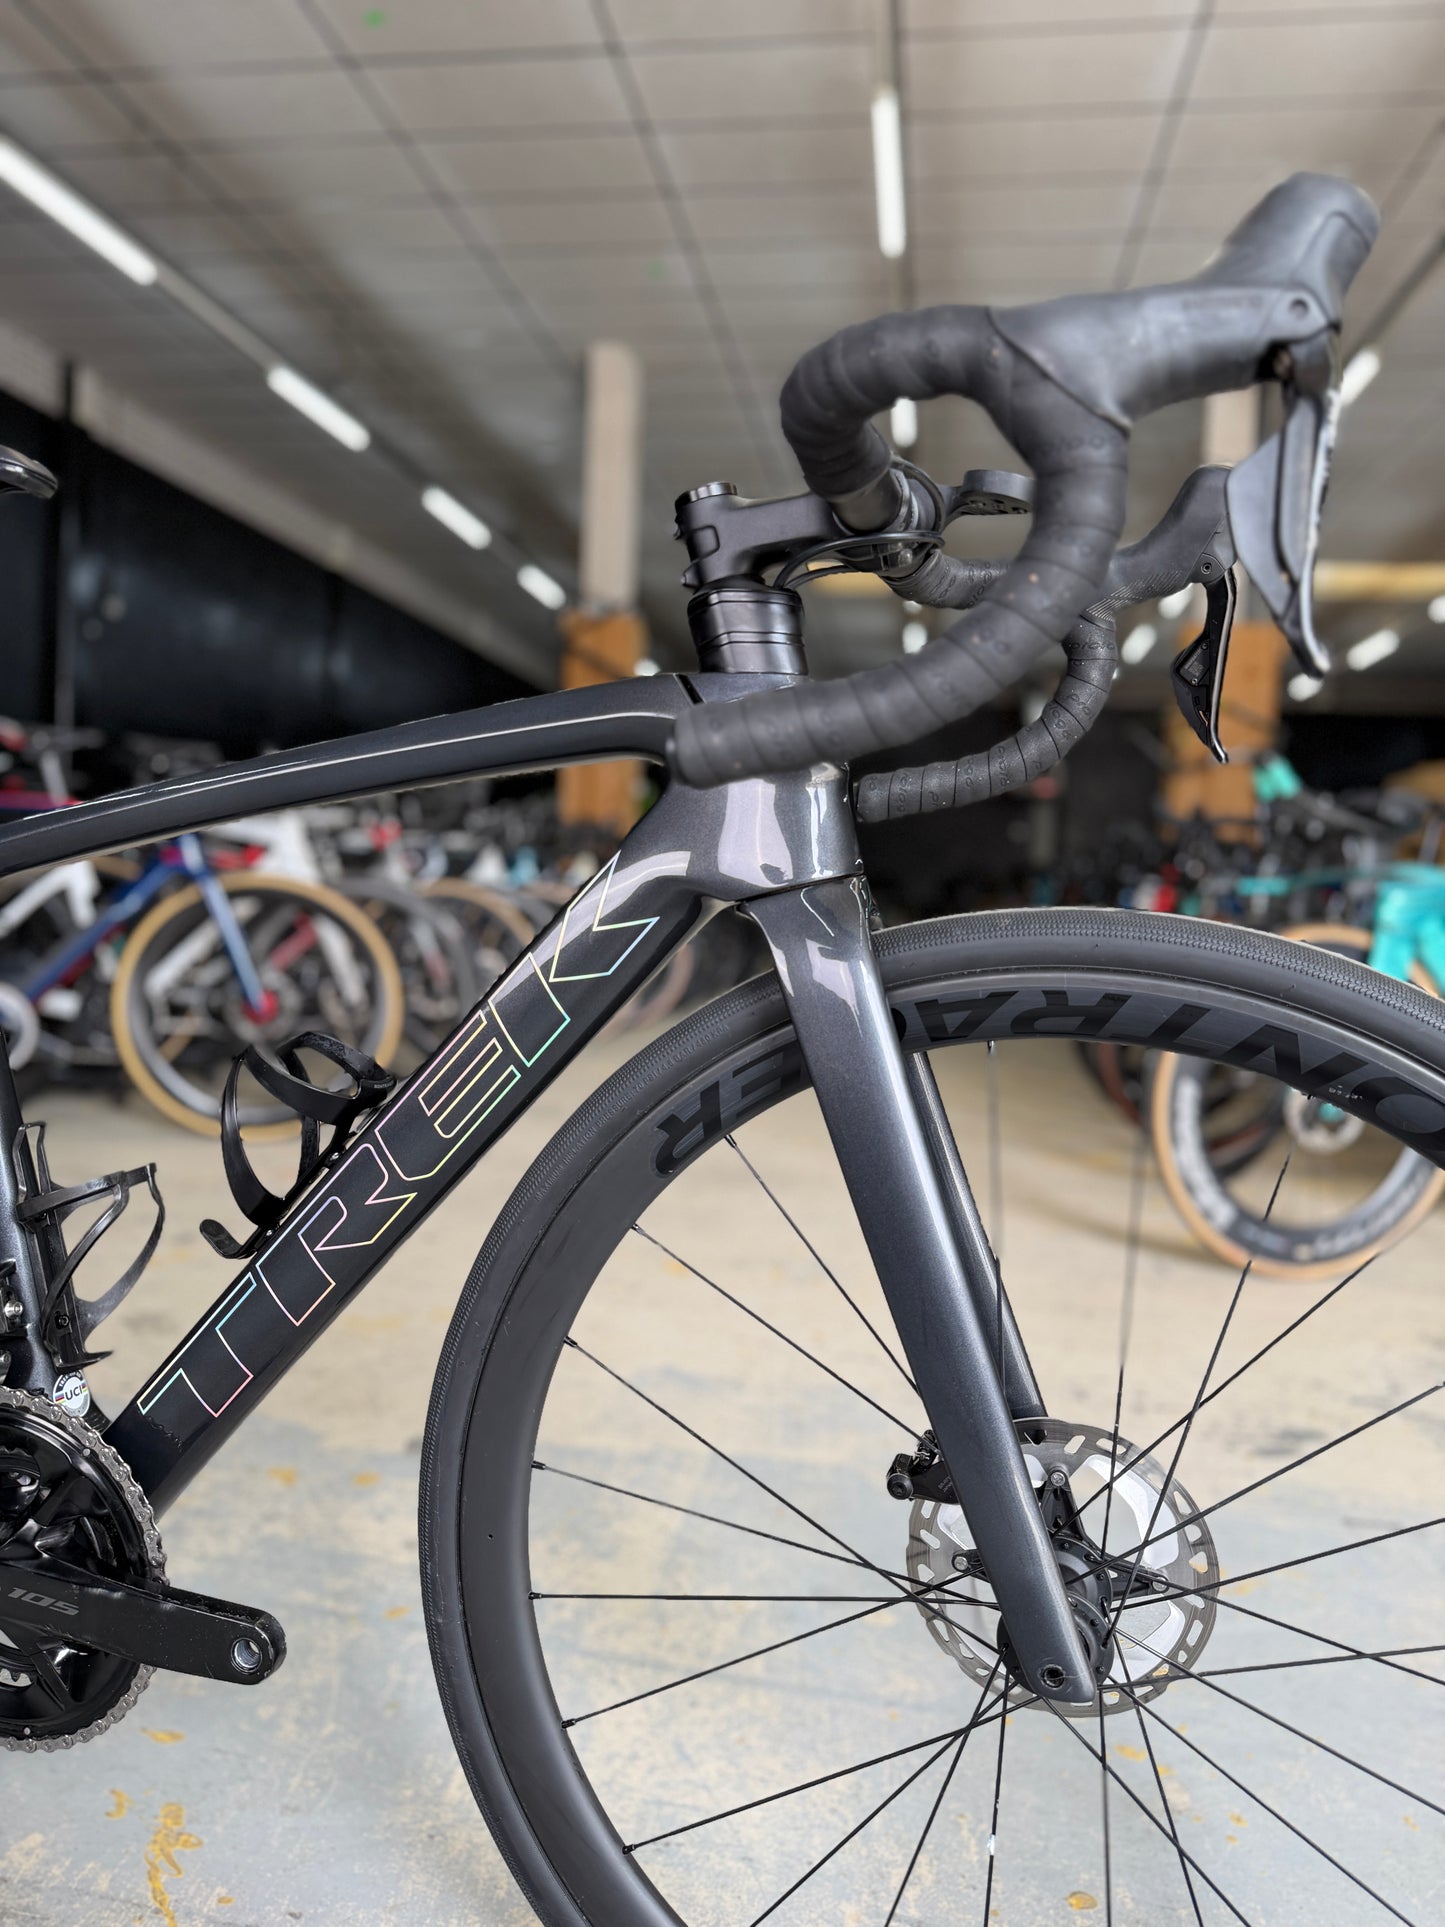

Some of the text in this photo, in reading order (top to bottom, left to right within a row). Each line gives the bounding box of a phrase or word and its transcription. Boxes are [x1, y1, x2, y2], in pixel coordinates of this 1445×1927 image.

[137, 851, 660, 1417] TREK
[65, 1385, 83, 1401] UCI
[8, 1587, 80, 1616] 105
